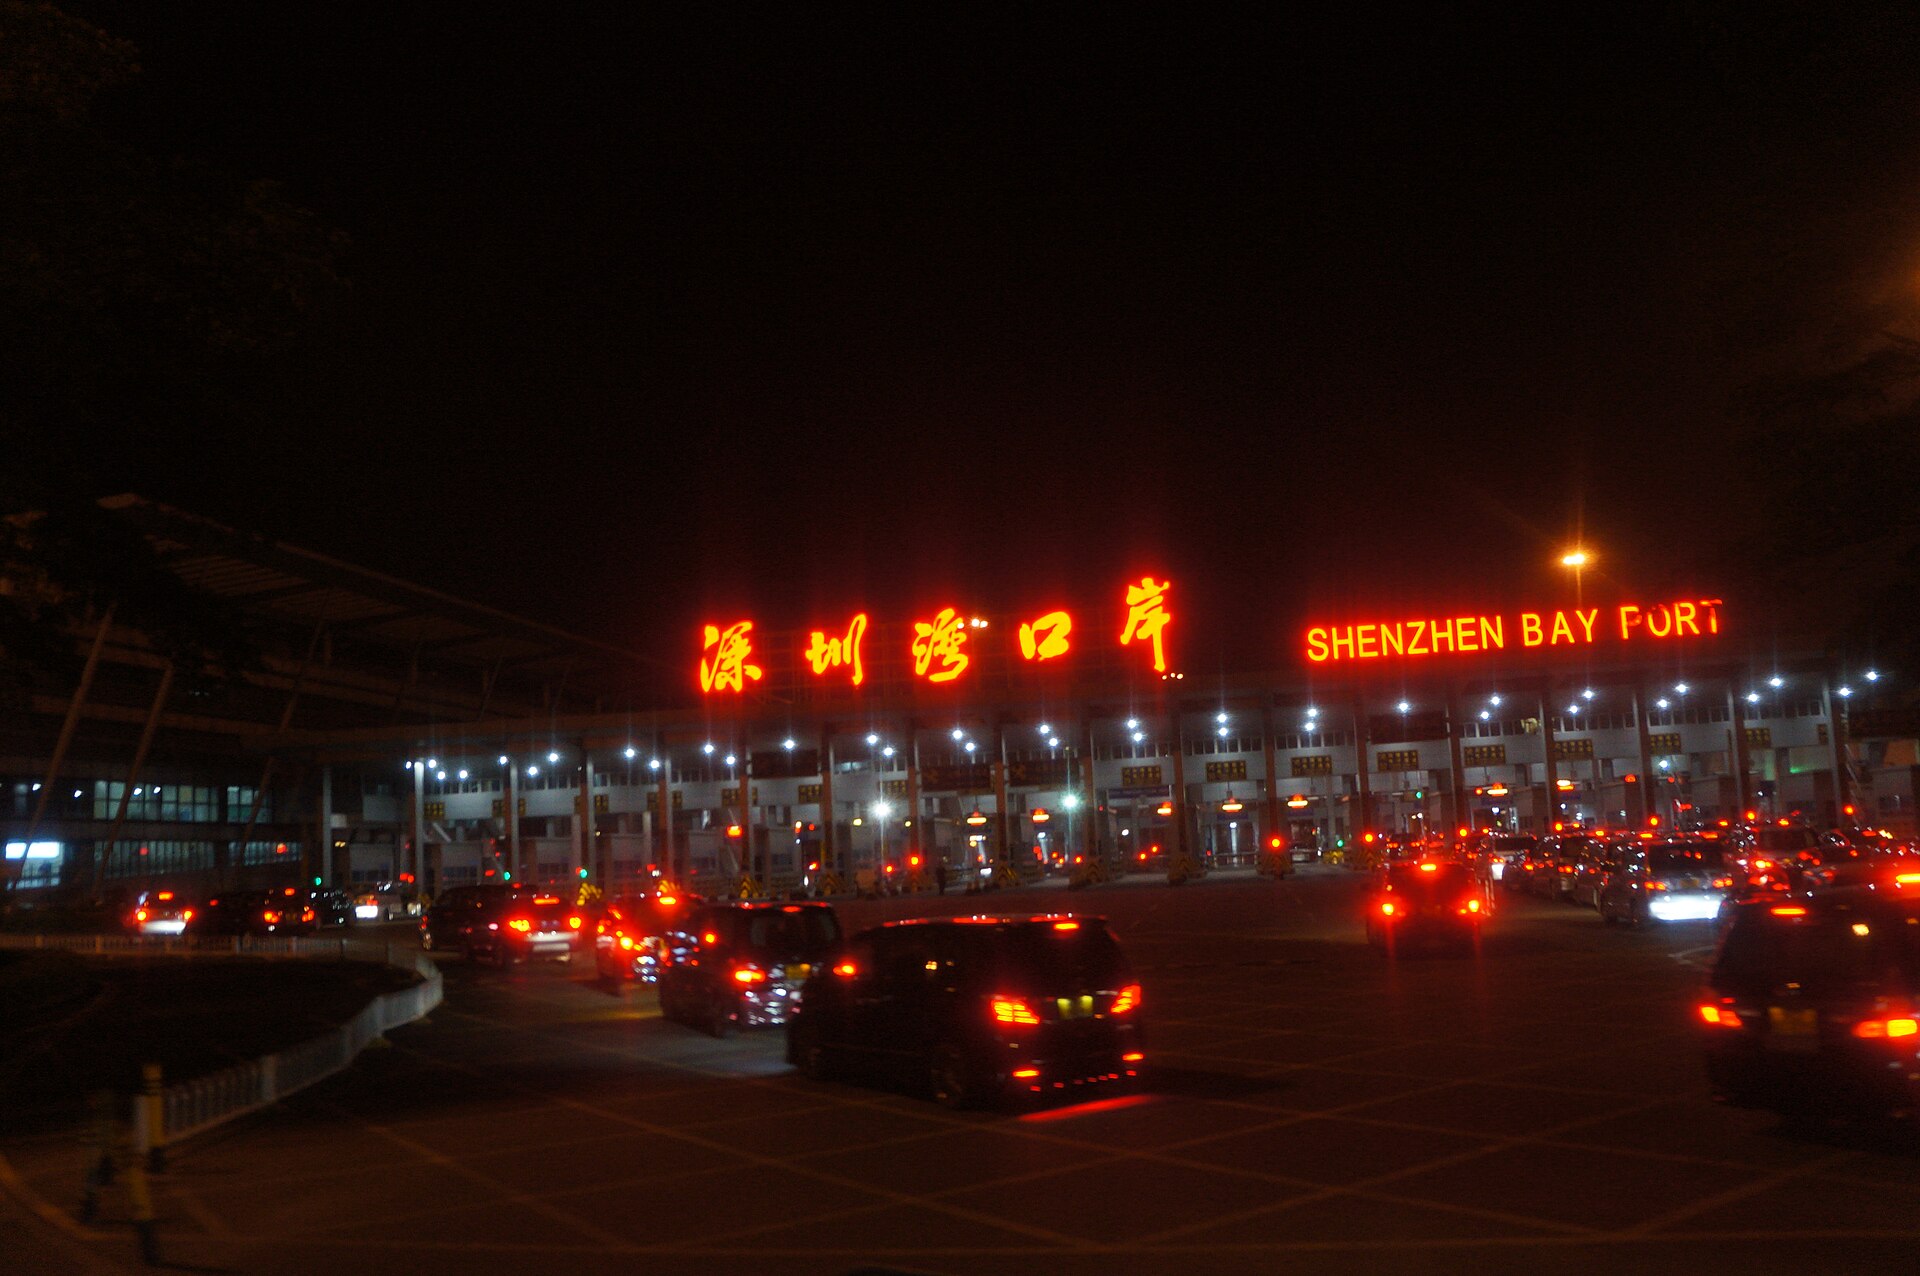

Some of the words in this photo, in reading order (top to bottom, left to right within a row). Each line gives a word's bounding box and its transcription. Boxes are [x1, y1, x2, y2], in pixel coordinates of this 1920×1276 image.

[699, 576, 1173, 693] 深圳湾口岸
[1305, 615, 1505, 664] SHENZHEN
[1521, 607, 1599, 648] BAY
[1619, 598, 1723, 641] PORT
